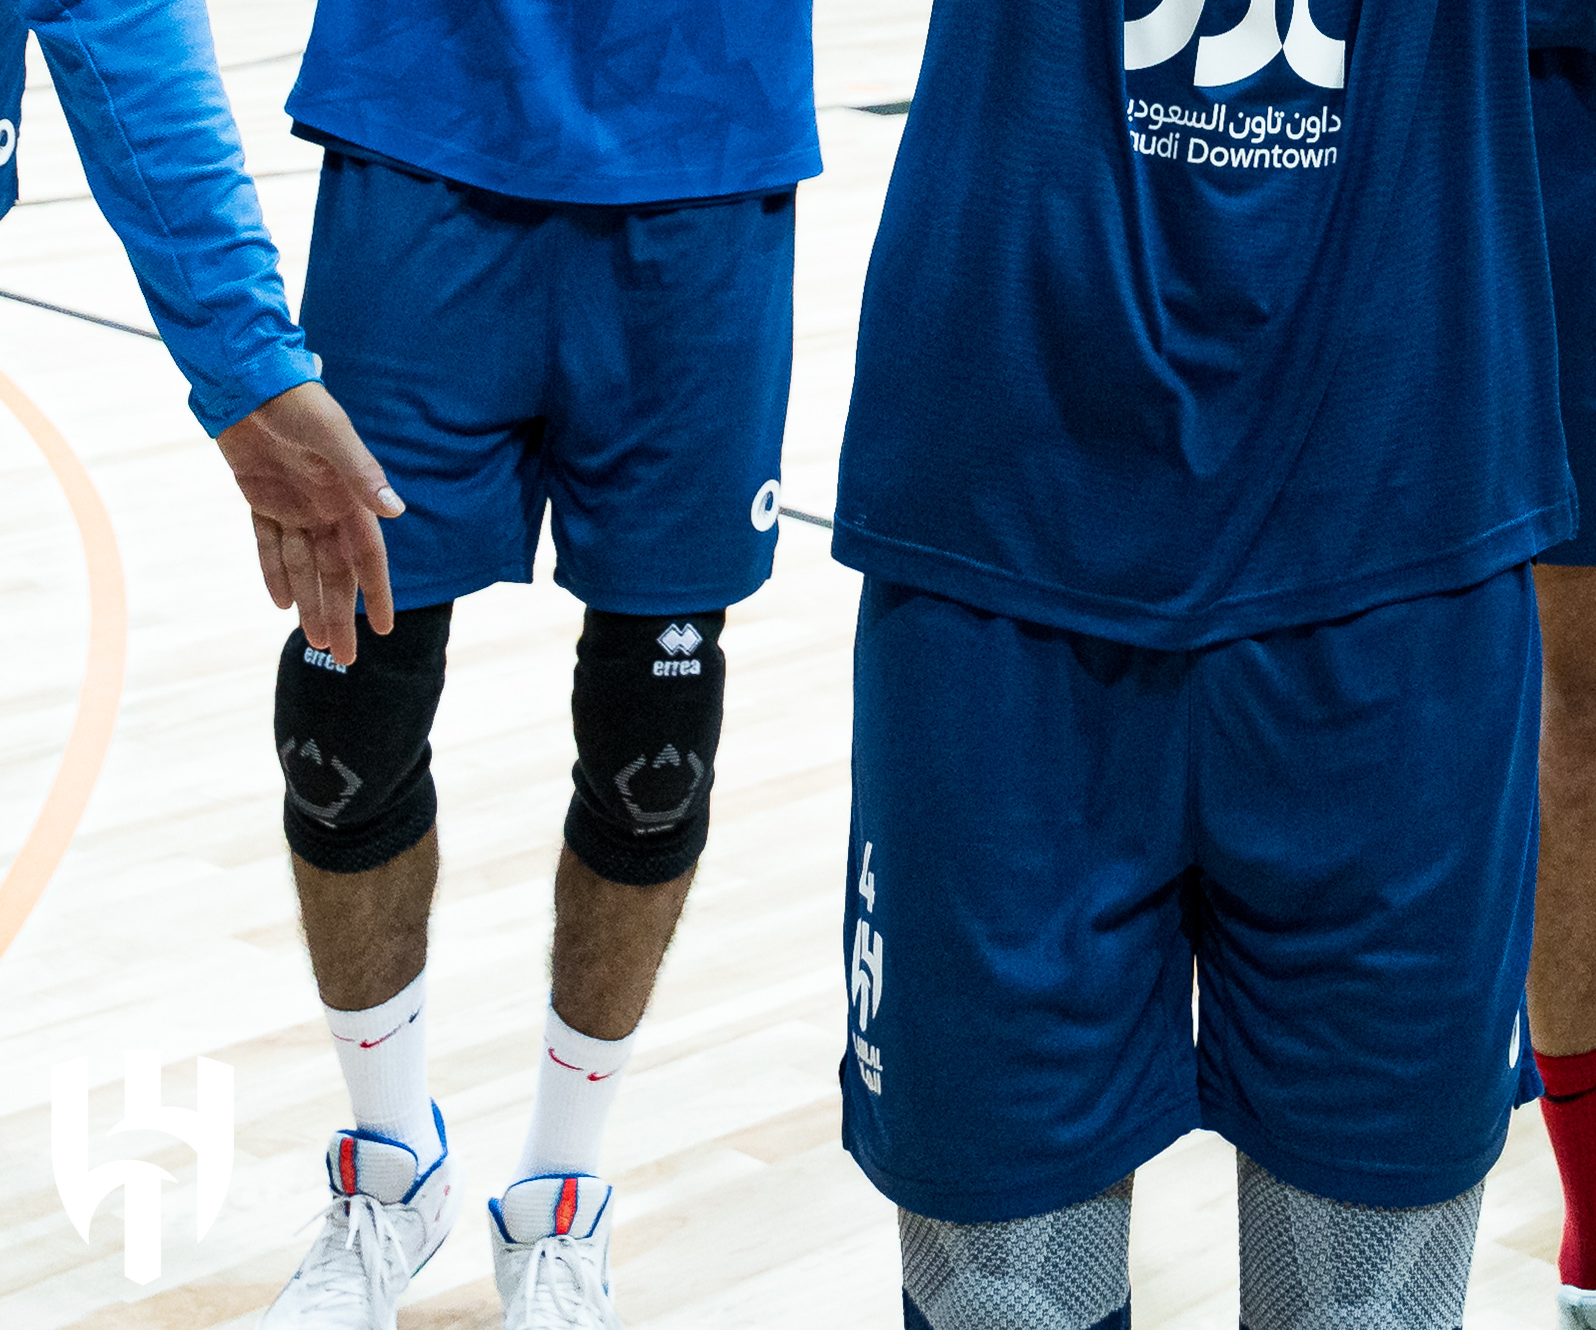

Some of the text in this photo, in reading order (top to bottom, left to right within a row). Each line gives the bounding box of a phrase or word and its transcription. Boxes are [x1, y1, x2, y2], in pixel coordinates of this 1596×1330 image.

[1229, 106, 1285, 144] تاون
[1286, 106, 1342, 143] داون
[1187, 137, 1337, 168] Downtown
[653, 659, 701, 676] errea
[859, 841, 875, 913] 4
